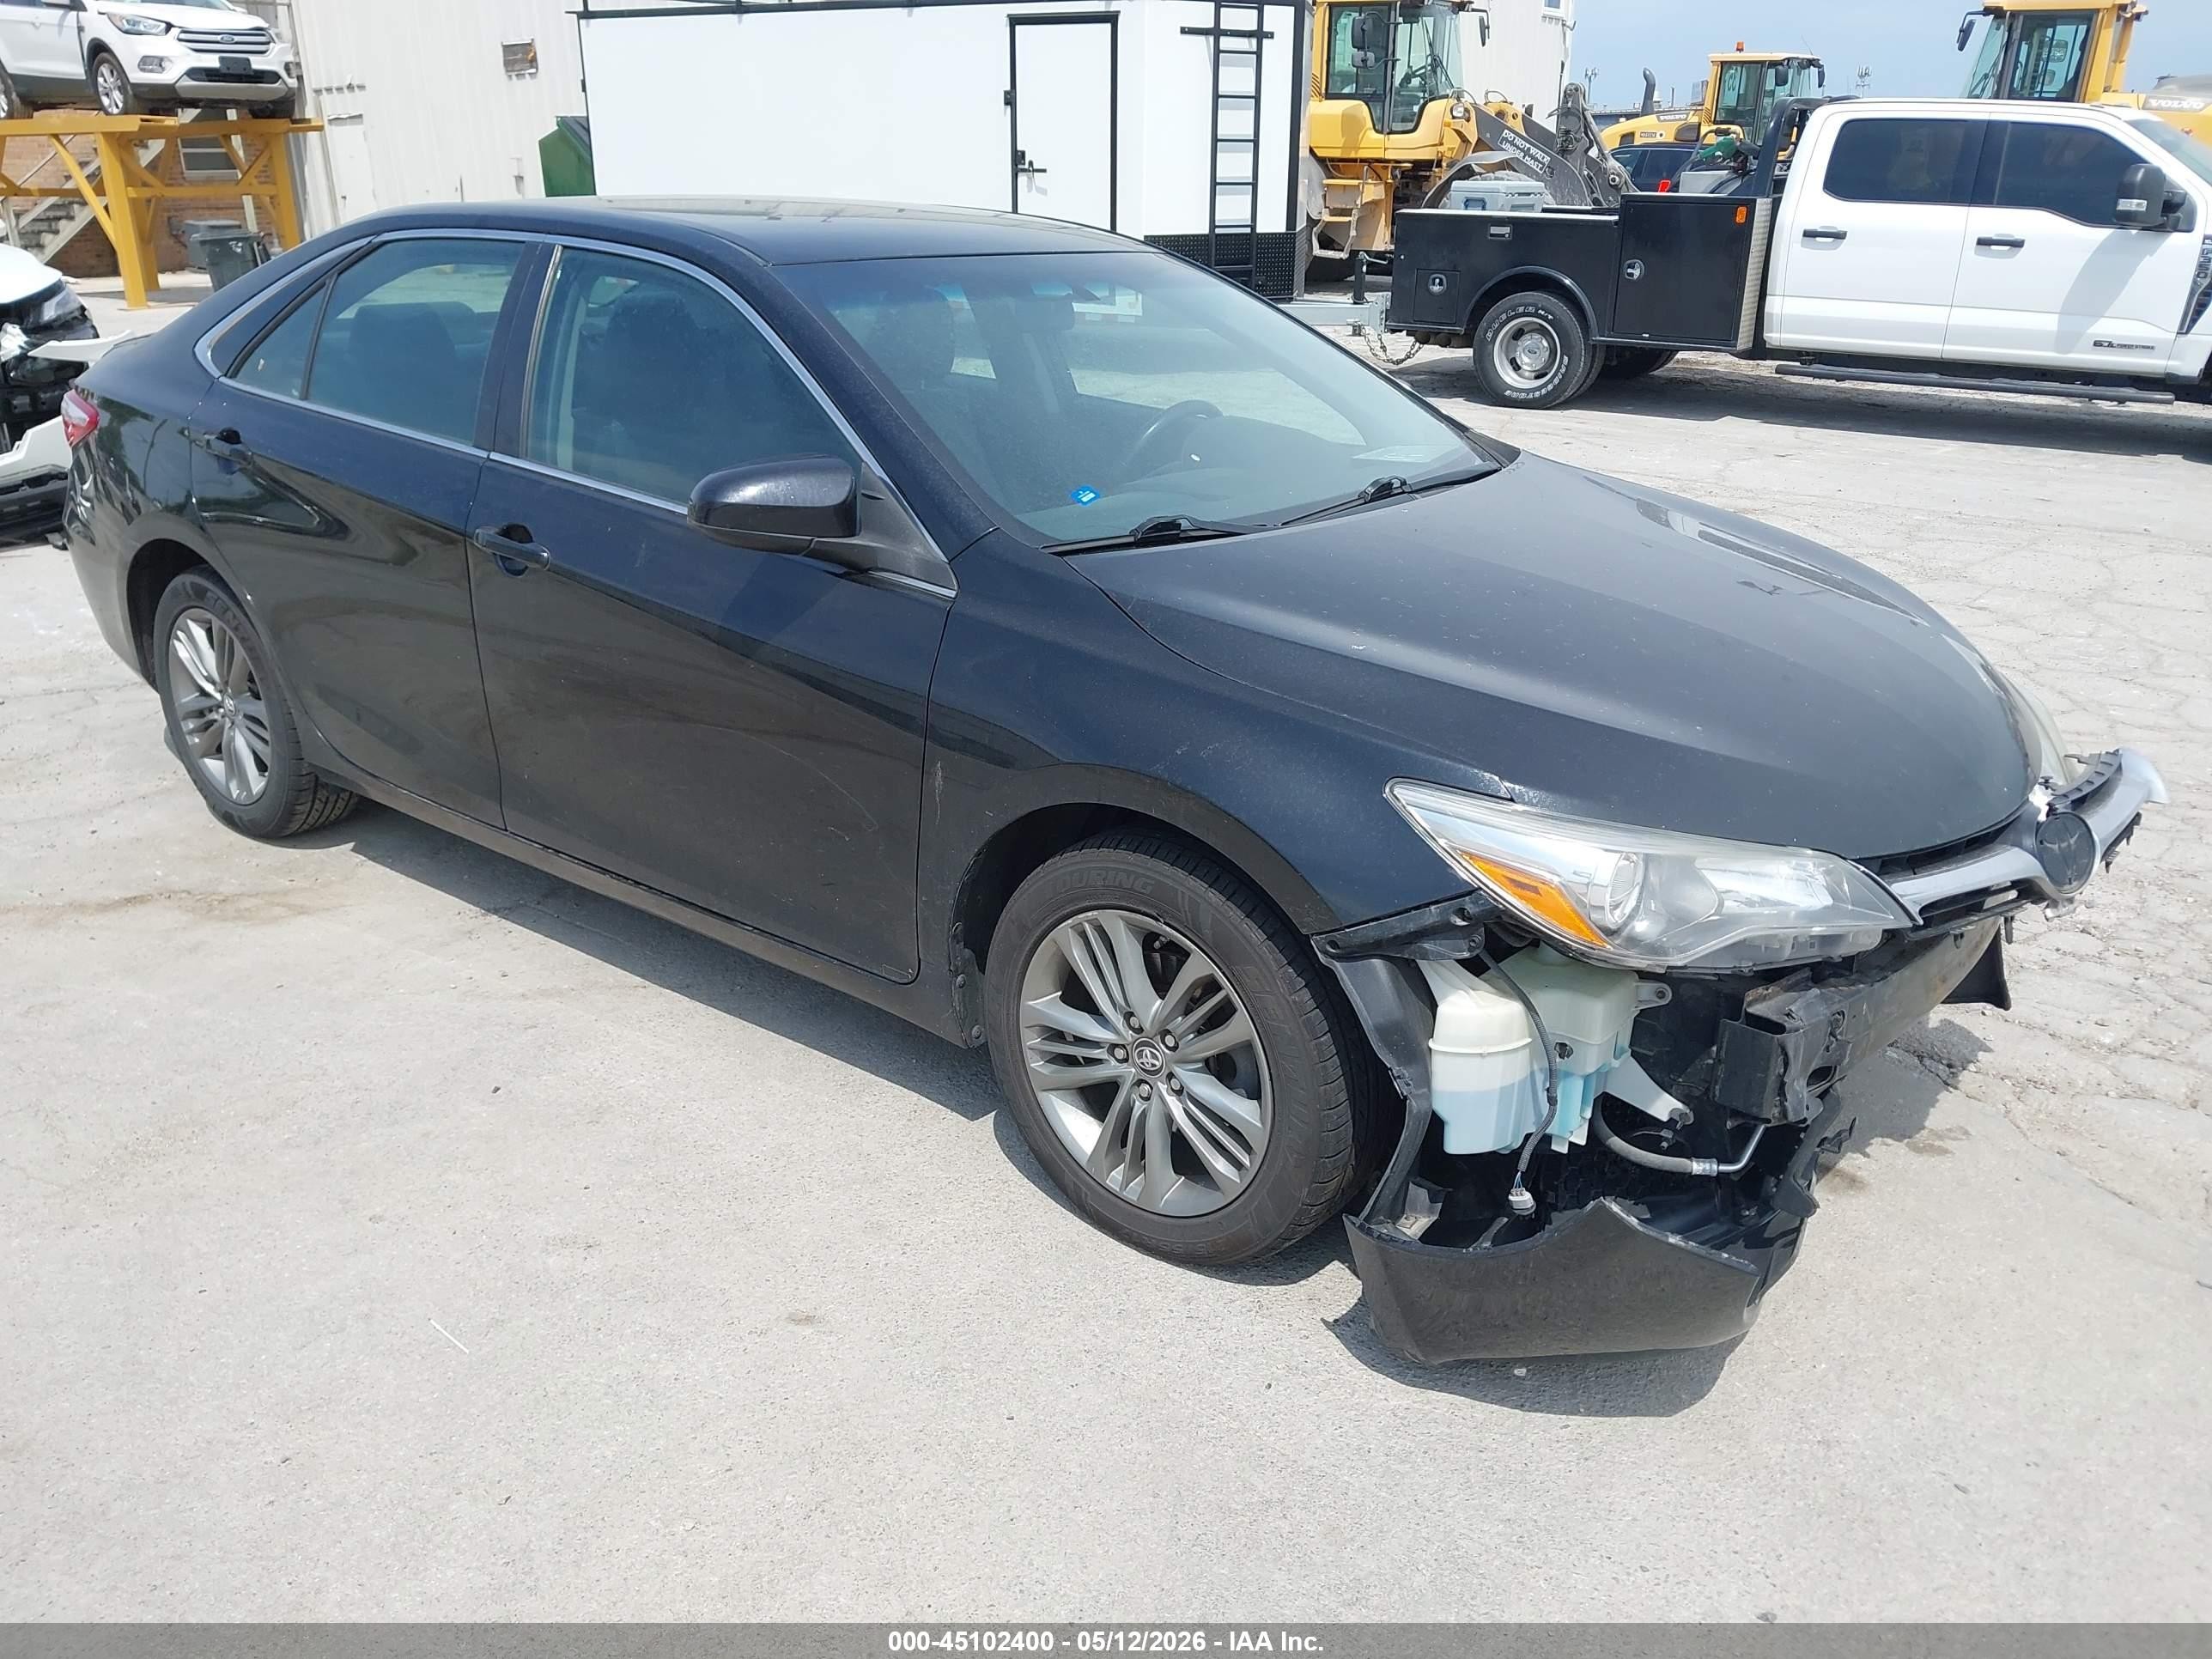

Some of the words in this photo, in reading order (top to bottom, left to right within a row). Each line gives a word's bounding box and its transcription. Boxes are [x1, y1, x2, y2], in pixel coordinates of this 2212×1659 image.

[2148, 99, 2206, 110] VOLVO
[1502, 140, 1525, 160] UNDER
[1524, 155, 1543, 172] MAST
[1503, 131, 1514, 141] DO
[1514, 137, 1528, 150] NOT
[1528, 145, 1549, 164] WALK
[1486, 306, 1535, 342] DUELER
[1504, 355, 1569, 399] BRIDGESTONE
